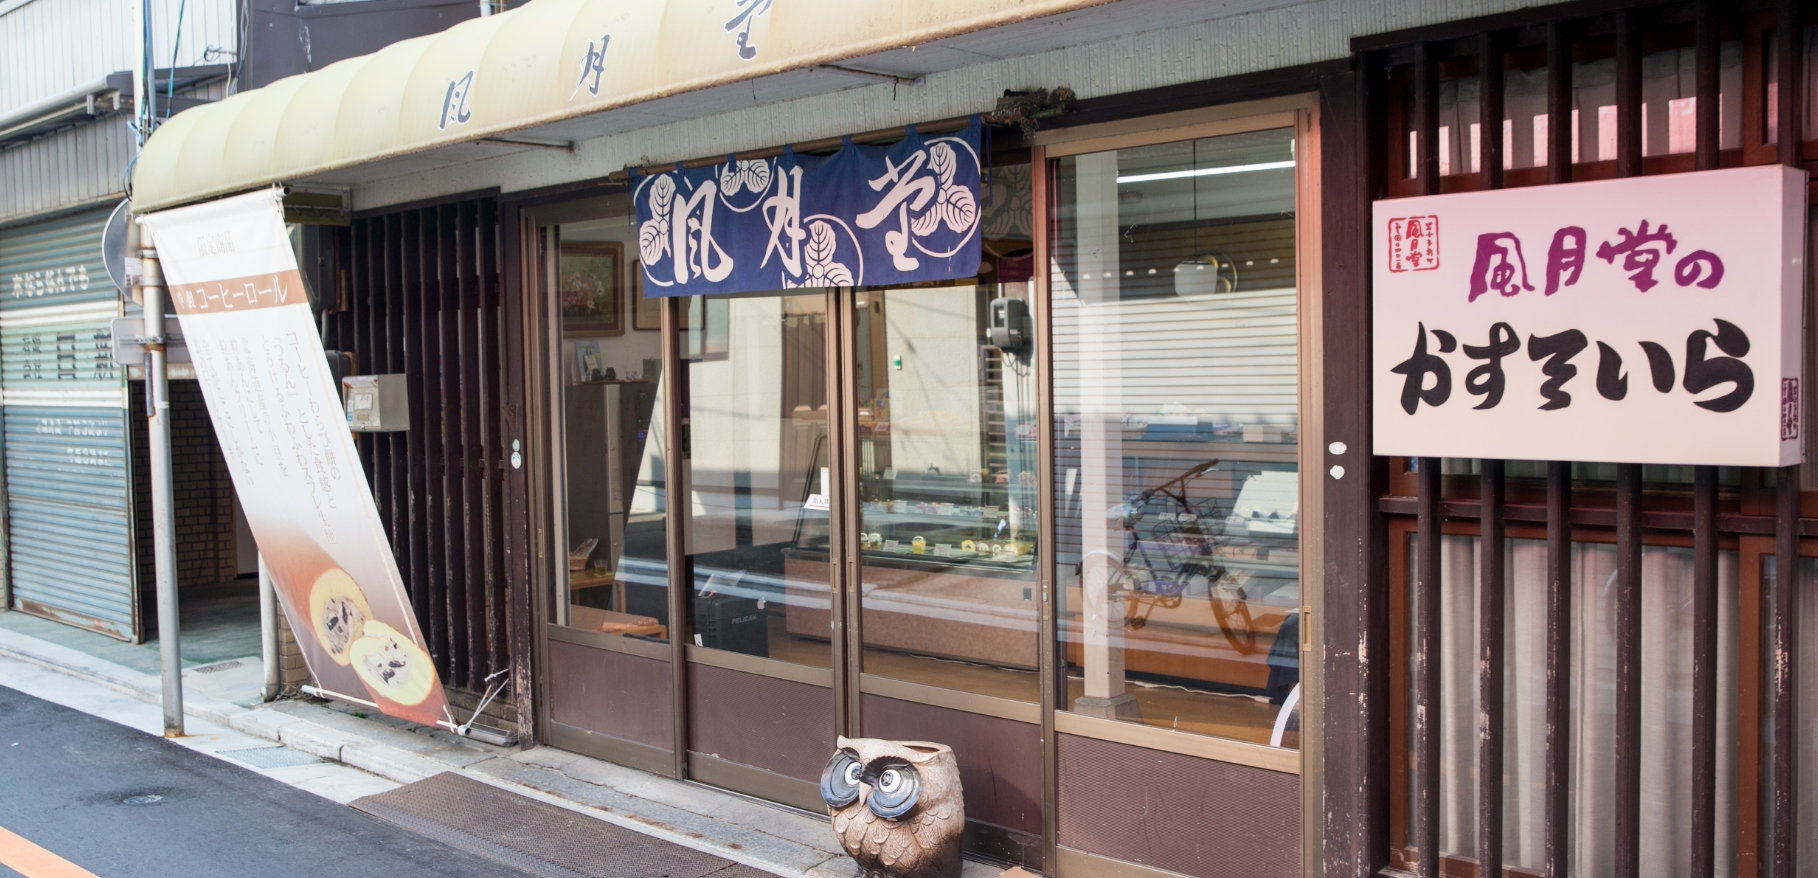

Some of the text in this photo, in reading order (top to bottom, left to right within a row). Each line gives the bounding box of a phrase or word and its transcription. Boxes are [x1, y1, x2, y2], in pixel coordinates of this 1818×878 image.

[672, 150, 941, 285] 風月堂
[1467, 219, 1725, 303] 風月堂の
[731, 614, 757, 625] PELICAN
